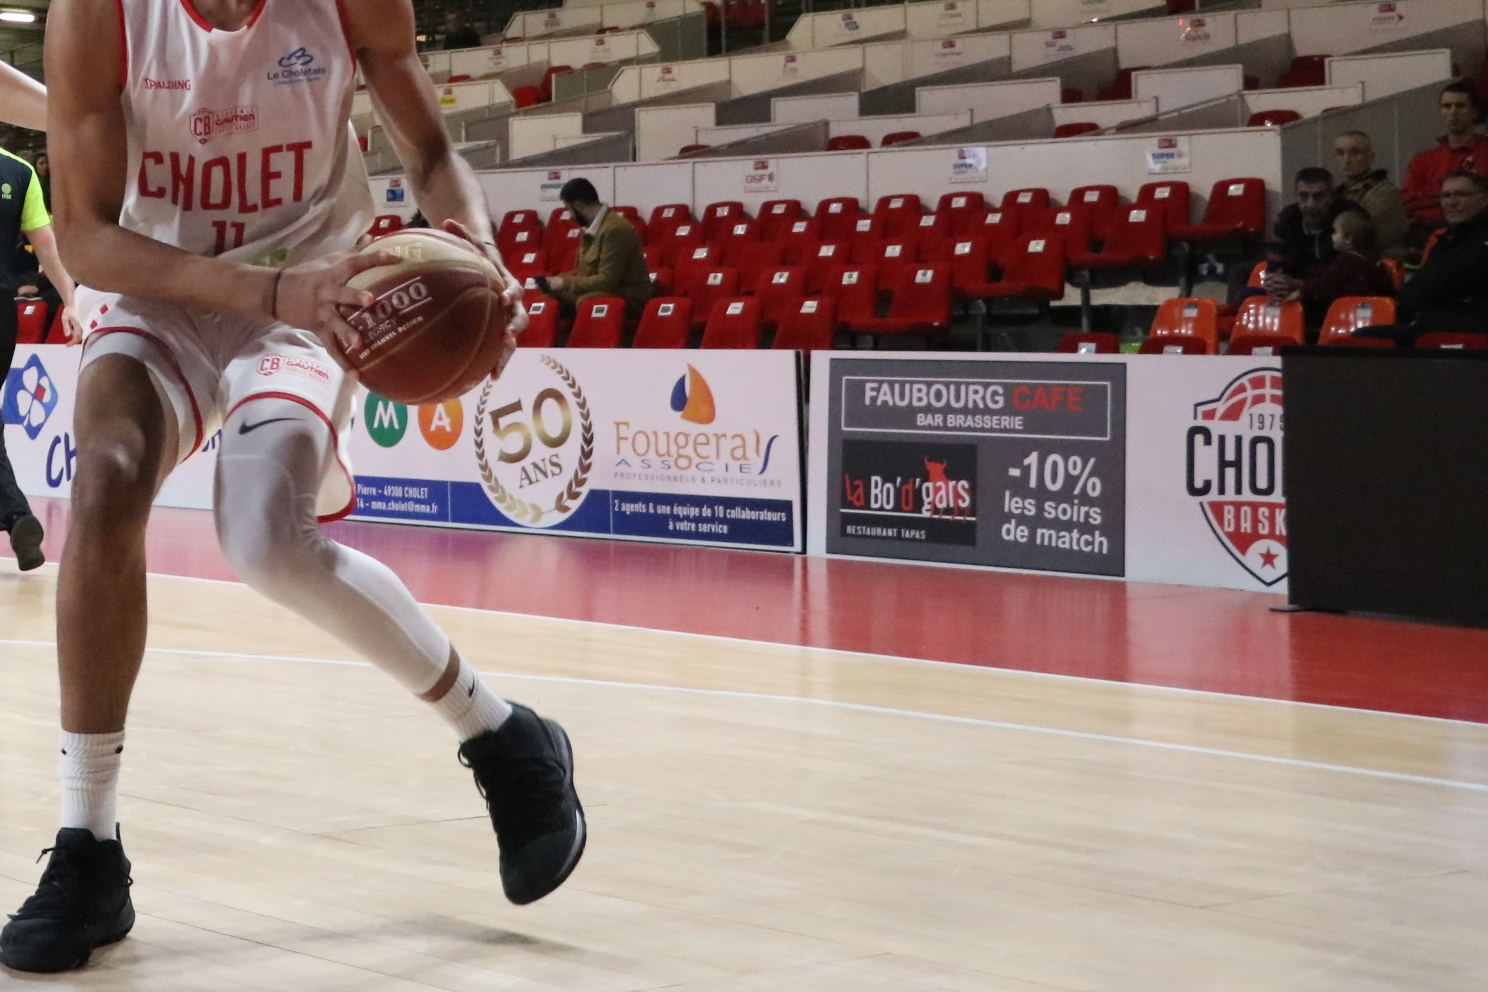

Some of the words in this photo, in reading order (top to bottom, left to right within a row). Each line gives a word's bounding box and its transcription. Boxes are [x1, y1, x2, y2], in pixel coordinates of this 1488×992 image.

[144, 77, 192, 91] SPALDING
[267, 70, 280, 82] Le
[281, 66, 327, 79] Choletais
[193, 114, 212, 138] CB
[137, 140, 313, 214] CHOLET
[211, 220, 246, 256] 11
[370, 331, 397, 351] CHANNEL
[260, 357, 280, 372] CB
[864, 381, 1005, 410] FAUBOURG
[1012, 385, 1086, 413] CAFE
[373, 399, 400, 430] M
[430, 402, 452, 433] A
[488, 387, 572, 465] 50
[916, 413, 943, 427] BAR
[946, 414, 1024, 430] BRASSERIE
[517, 453, 563, 490] ANS
[1185, 424, 1286, 498] CHO
[613, 471, 697, 484] PROFESSIONNELS
[700, 476, 707, 484] &
[710, 477, 783, 488] PARTICULIERS
[1008, 451, 1102, 497] -10%
[357, 483, 377, 496] Pierre
[383, 484, 403, 498] 49300
[404, 486, 429, 500] CHOLET
[370, 497, 438, 515] mma.cholet@mma.fr
[614, 499, 619, 512] 2
[621, 501, 647, 516] agents
[648, 502, 654, 514] &
[656, 504, 671, 514] une
[673, 502, 700, 520] équipe
[701, 504, 711, 517] de
[714, 505, 724, 518] 10
[726, 507, 787, 523] collaborateurs
[1003, 490, 1036, 516] les
[1043, 499, 1102, 525] soirs
[668, 518, 674, 531] à
[675, 521, 696, 532] votre
[698, 523, 729, 534] service
[846, 524, 898, 538] RESTAURANT
[901, 527, 926, 540] TAPAS
[1001, 518, 1029, 543] de
[1036, 526, 1109, 555] match
